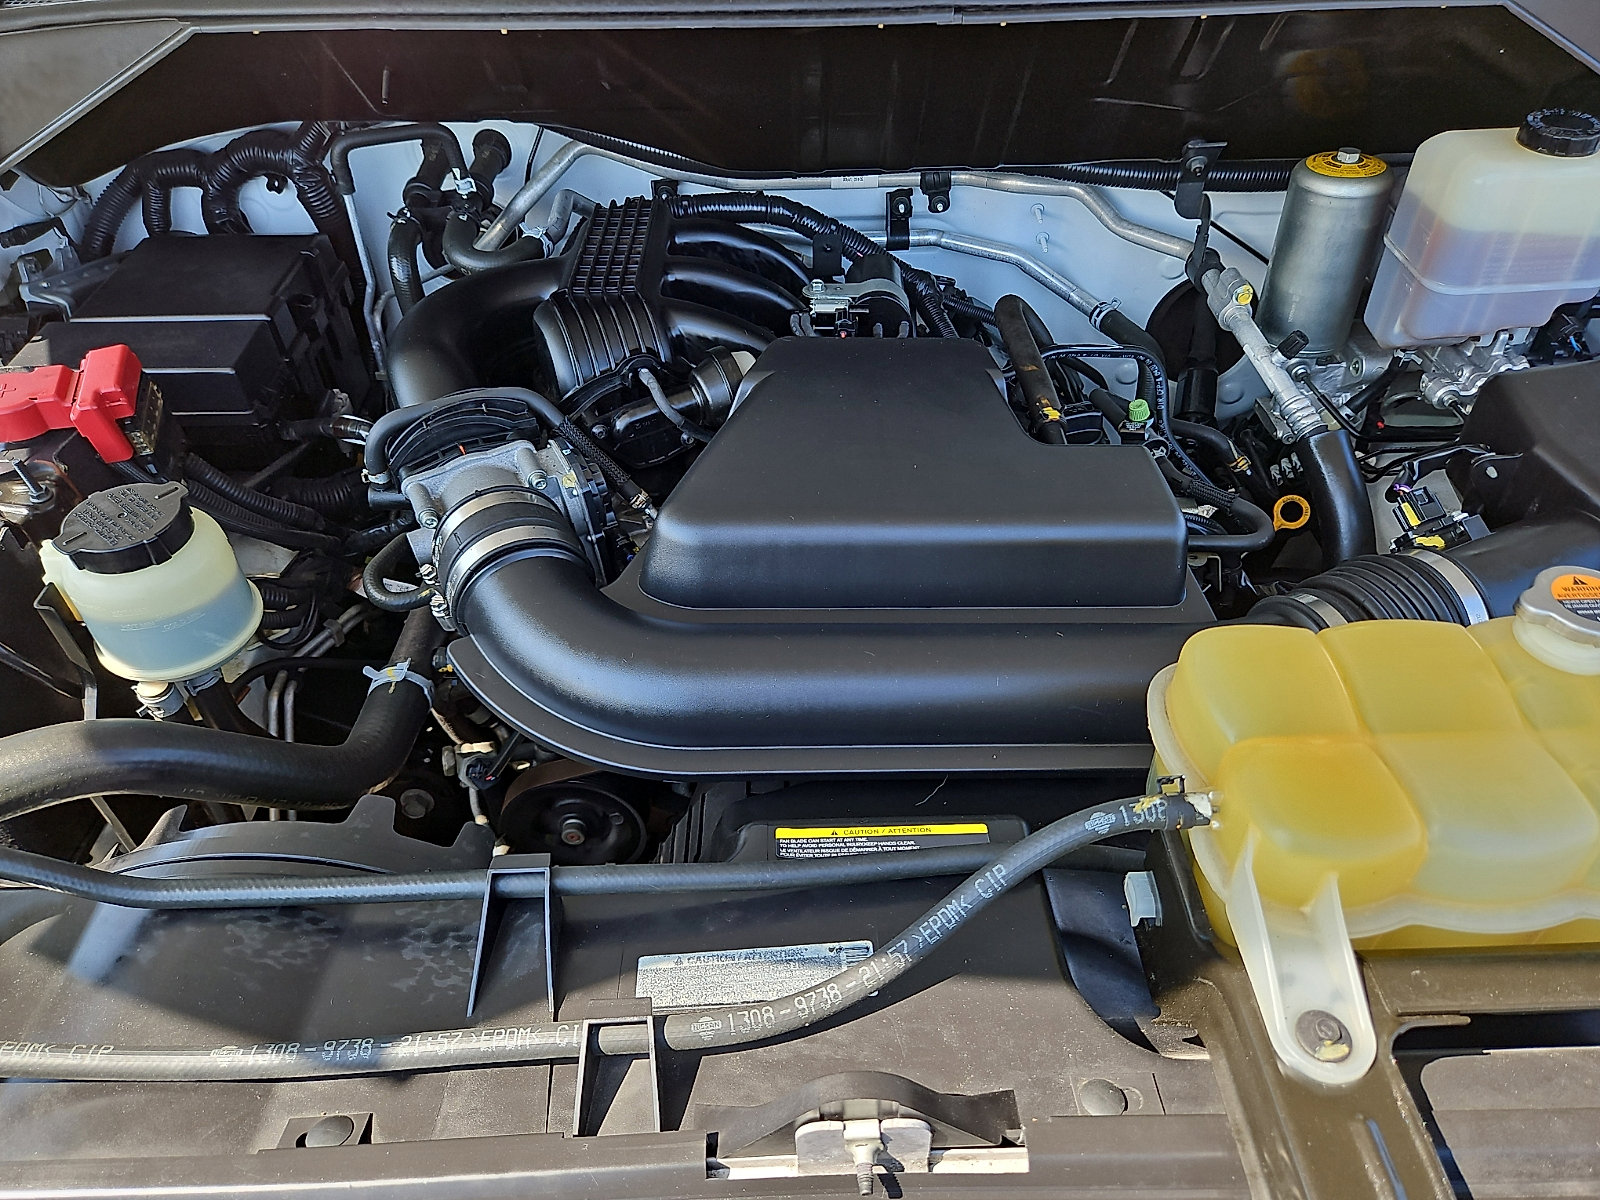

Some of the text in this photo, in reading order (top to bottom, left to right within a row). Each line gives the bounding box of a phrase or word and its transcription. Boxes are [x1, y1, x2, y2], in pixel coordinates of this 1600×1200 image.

[727, 1006, 777, 1036] 1308
[794, 982, 843, 1020] 9738
[247, 1042, 301, 1065] 1308
[321, 1037, 375, 1061] 9738
